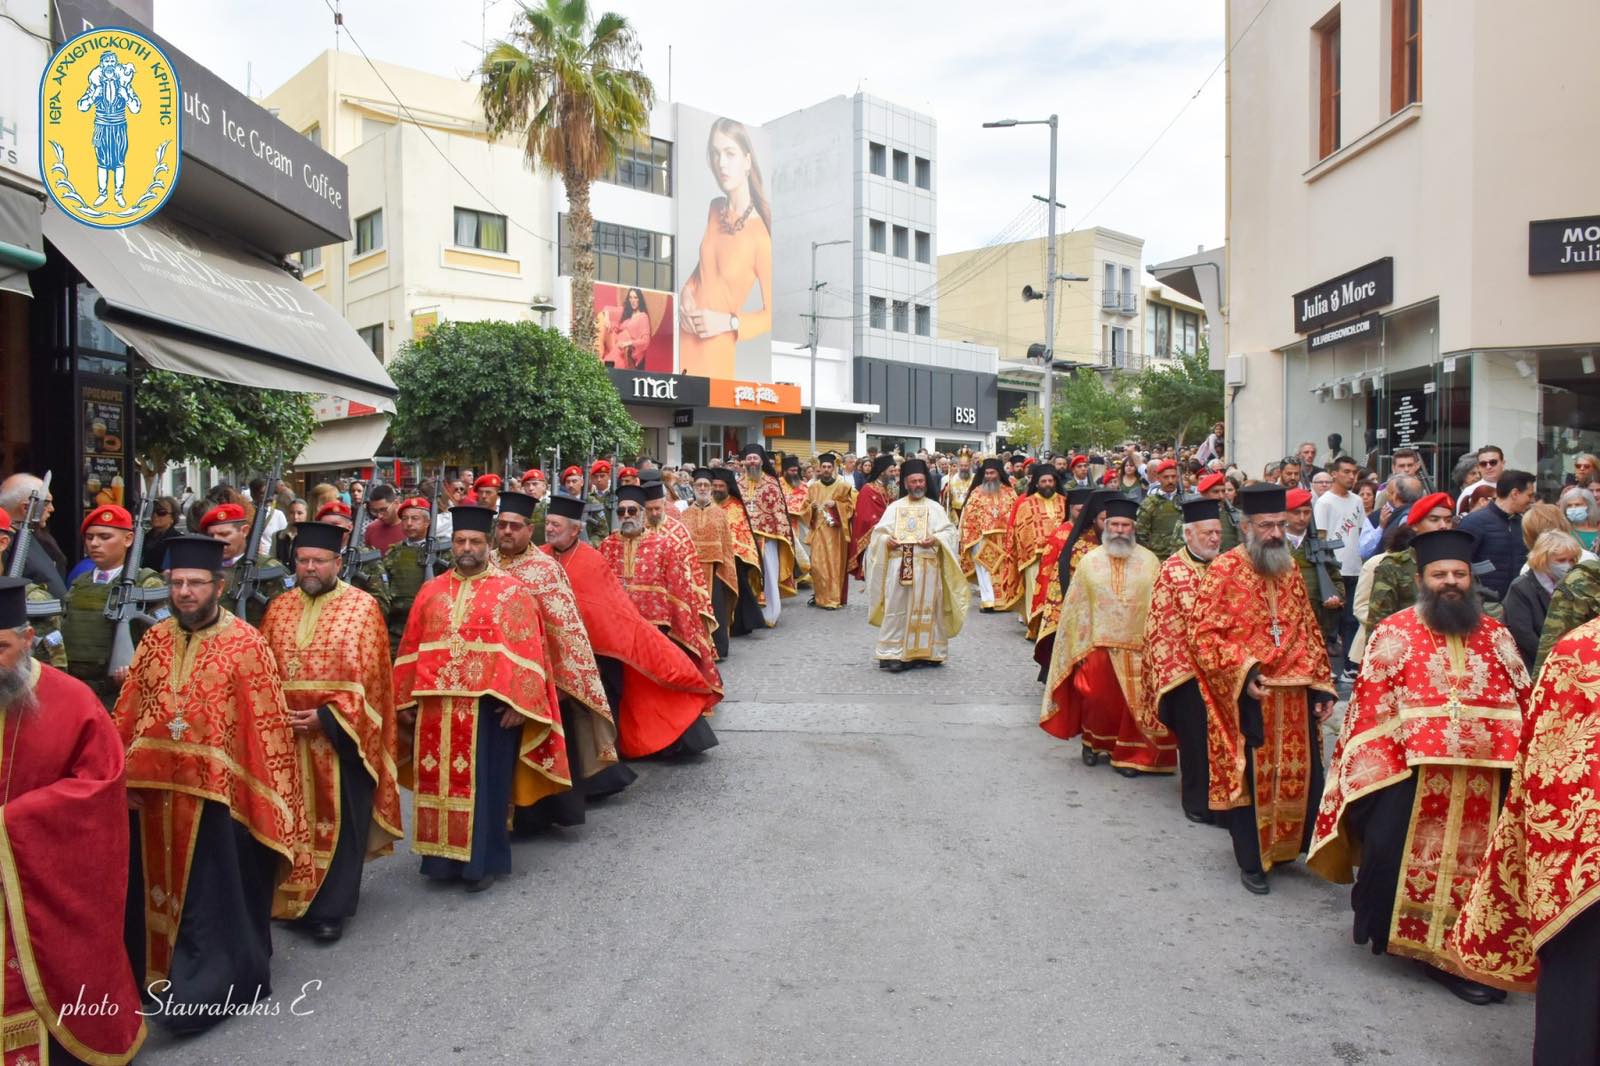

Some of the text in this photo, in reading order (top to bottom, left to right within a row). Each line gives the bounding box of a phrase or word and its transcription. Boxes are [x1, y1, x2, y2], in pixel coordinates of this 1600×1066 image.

[222, 110, 246, 148] Ice
[250, 130, 293, 177] Cream
[303, 164, 342, 209] Coffee
[1302, 294, 1329, 322] Julia
[1341, 280, 1376, 307] More
[956, 406, 976, 424] BSB
